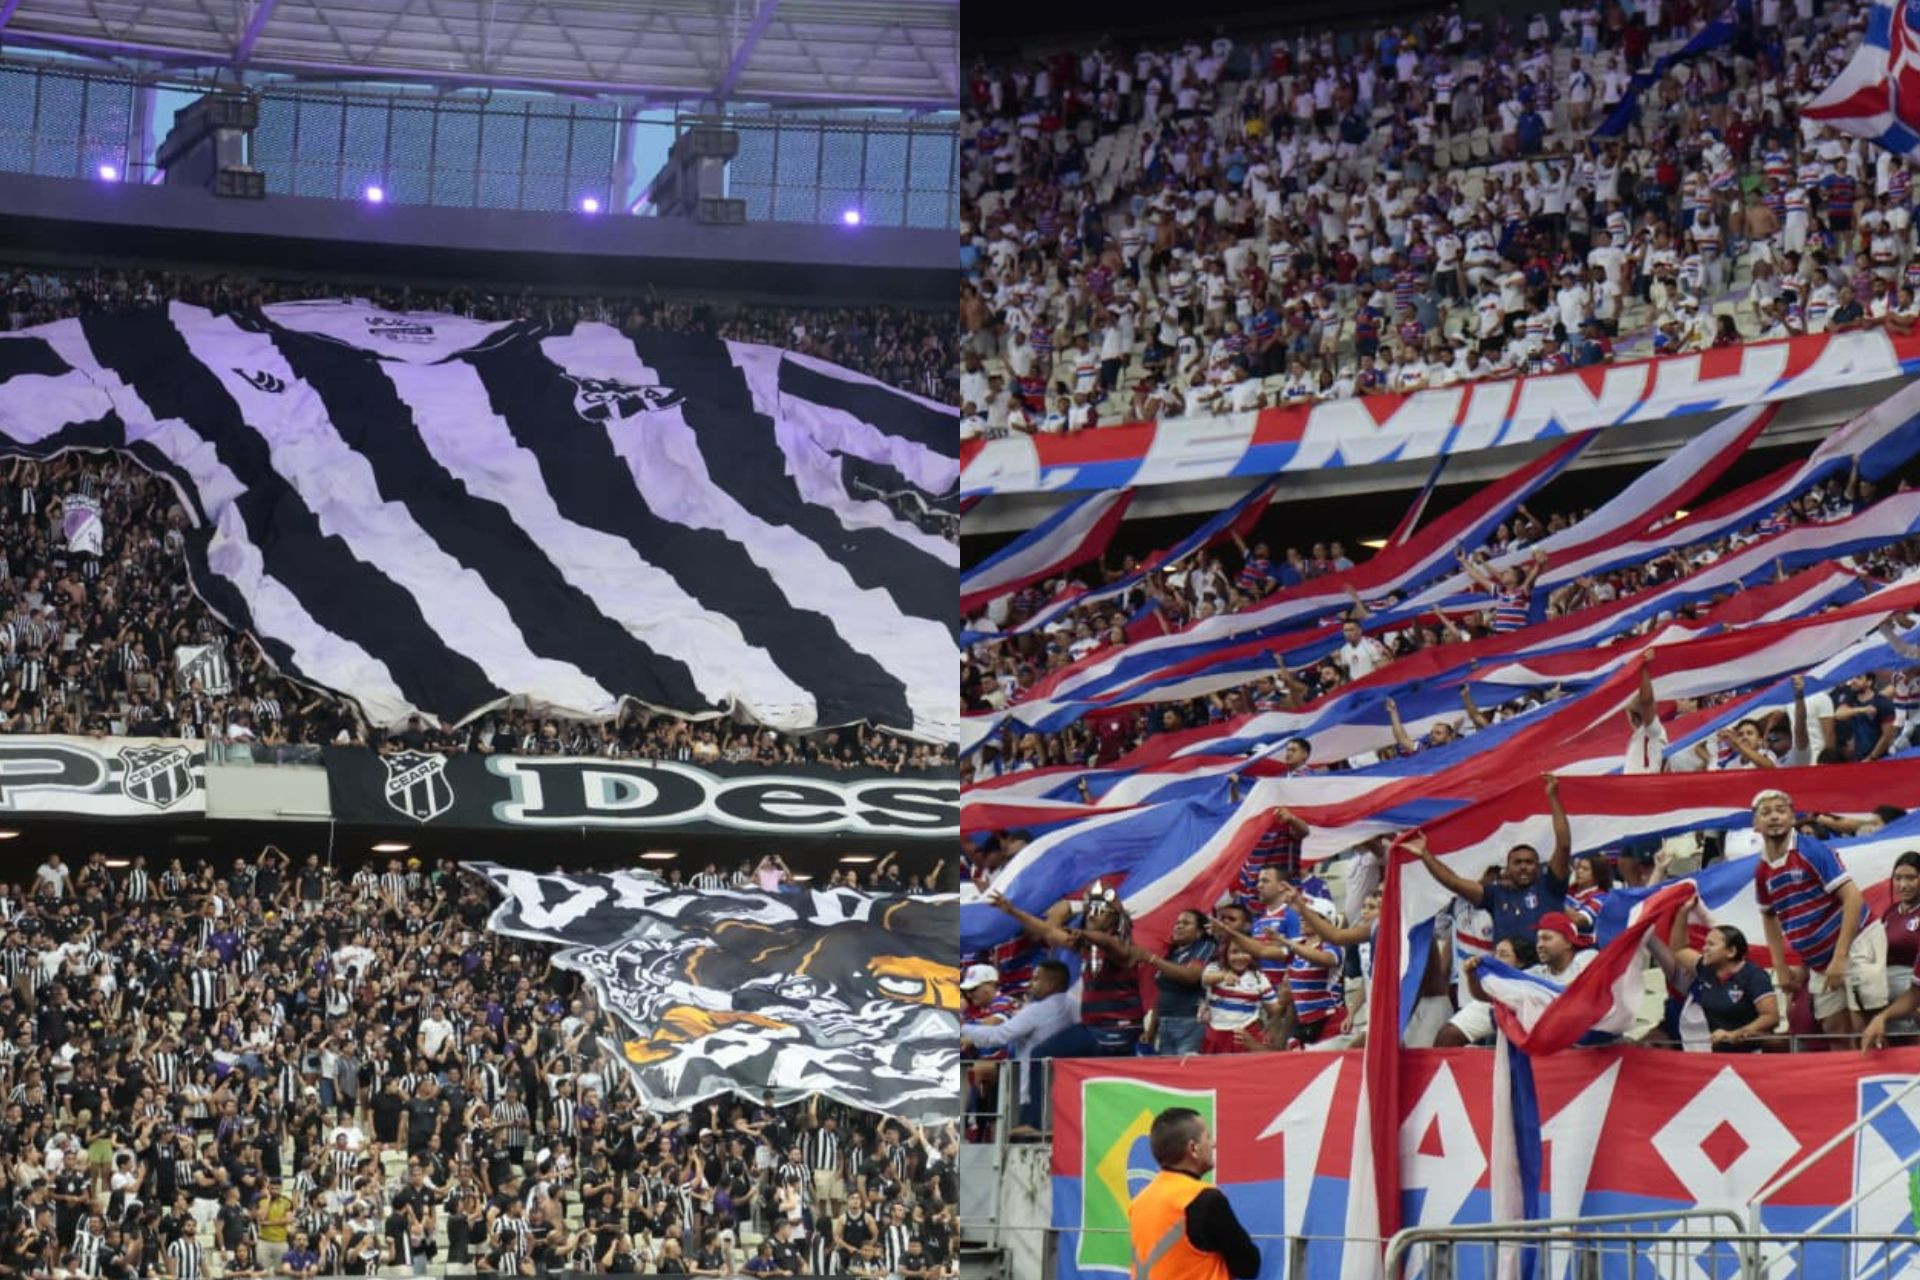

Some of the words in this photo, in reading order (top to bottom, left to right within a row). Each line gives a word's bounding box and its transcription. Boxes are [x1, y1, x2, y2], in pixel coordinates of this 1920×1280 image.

[1279, 326, 1904, 472] MINHA
[485, 756, 960, 837] Des
[1255, 1056, 1804, 1280] 1918
